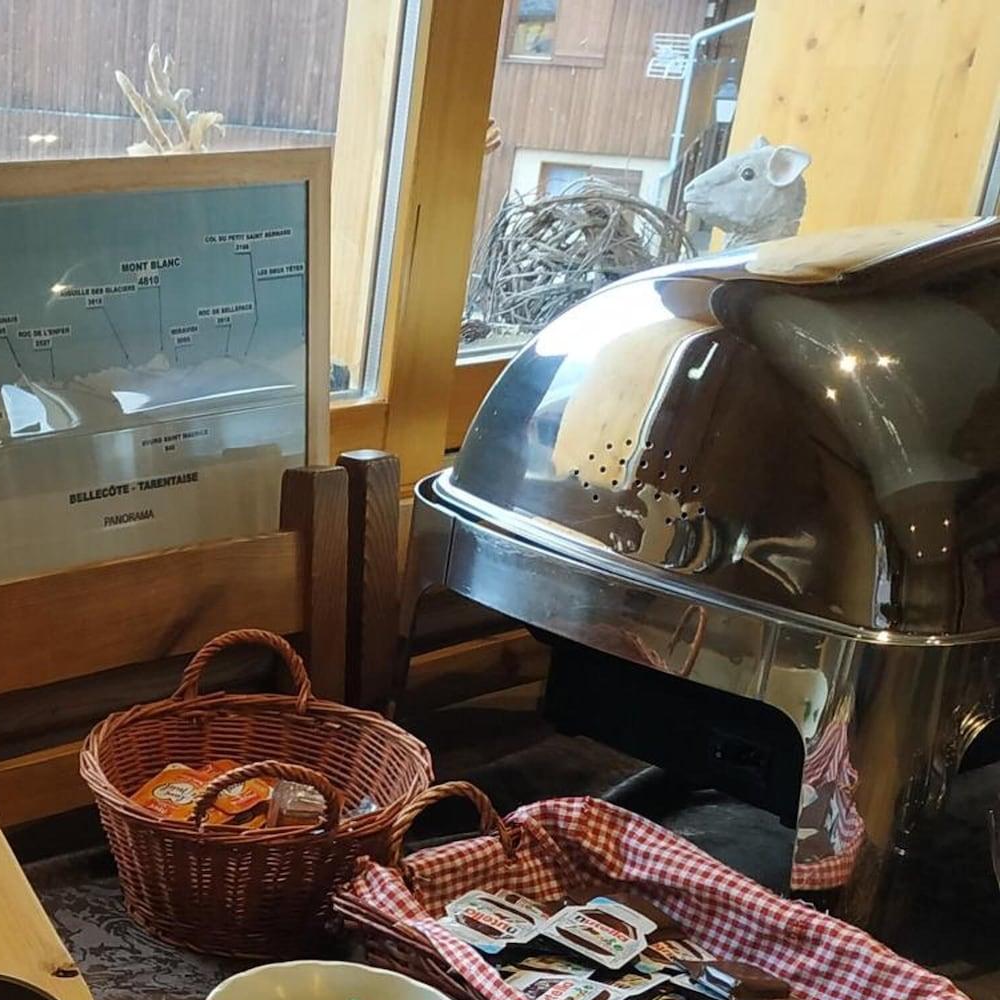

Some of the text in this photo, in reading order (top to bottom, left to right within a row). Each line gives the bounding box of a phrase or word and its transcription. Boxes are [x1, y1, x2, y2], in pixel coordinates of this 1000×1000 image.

[121, 258, 181, 272] MONT BLANC
[138, 276, 160, 286] 4810
[69, 485, 129, 505] BELLECÔTE
[137, 471, 199, 491] TARENTAISE
[104, 509, 155, 527] PANORAMA
